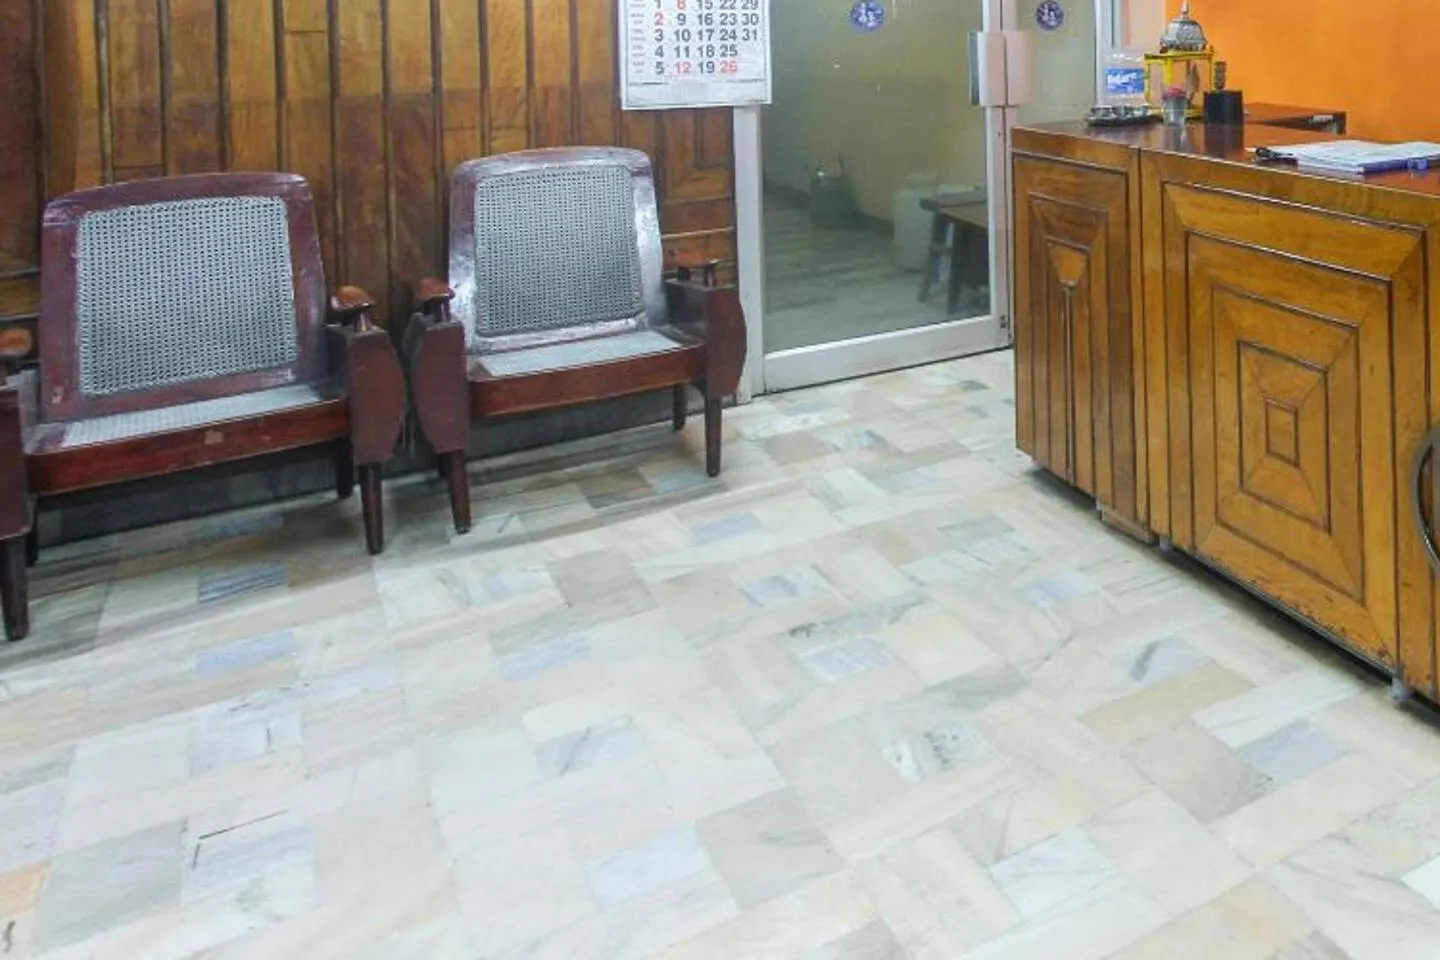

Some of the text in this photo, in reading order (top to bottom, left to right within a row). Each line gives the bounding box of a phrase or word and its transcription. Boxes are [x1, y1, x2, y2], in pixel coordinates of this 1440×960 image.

[654, 12, 664, 25] 2
[677, 13, 686, 26] 9
[697, 13, 713, 26] 16
[720, 13, 737, 26] 23
[740, 13, 759, 26] 30
[654, 28, 664, 41] 3
[673, 28, 691, 41] 10
[697, 28, 714, 41] 17
[720, 28, 737, 41] 24
[742, 28, 757, 41] 31
[654, 44, 664, 57] 4
[674, 45, 690, 58] 11
[697, 44, 715, 58] 18
[719, 44, 738, 57] 25
[655, 61, 665, 74] 5
[674, 61, 691, 74] 12
[697, 61, 715, 74] 19
[719, 61, 738, 74] 26
